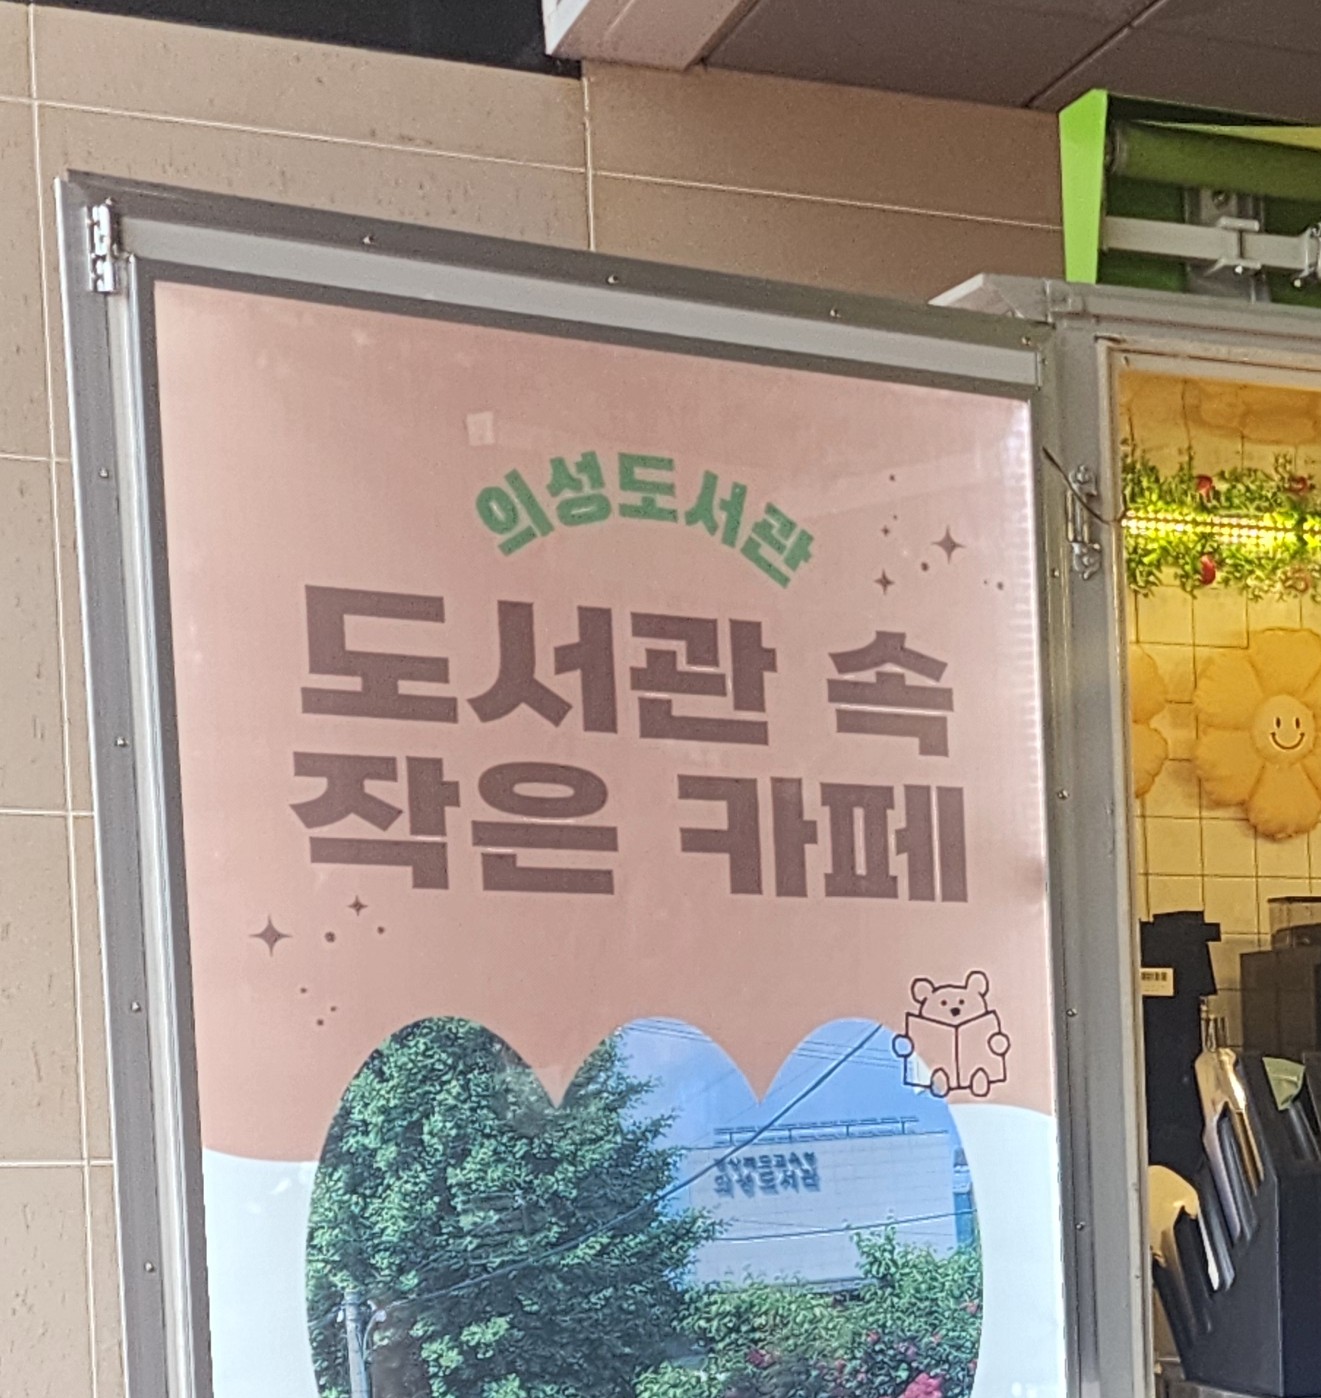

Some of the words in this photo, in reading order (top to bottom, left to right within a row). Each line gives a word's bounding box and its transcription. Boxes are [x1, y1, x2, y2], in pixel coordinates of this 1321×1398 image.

[476, 447, 814, 589] 의성도서관
[300, 584, 778, 746] 도서관
[826, 630, 954, 758] 속
[289, 751, 619, 895] 작은
[677, 774, 969, 904] 카페
